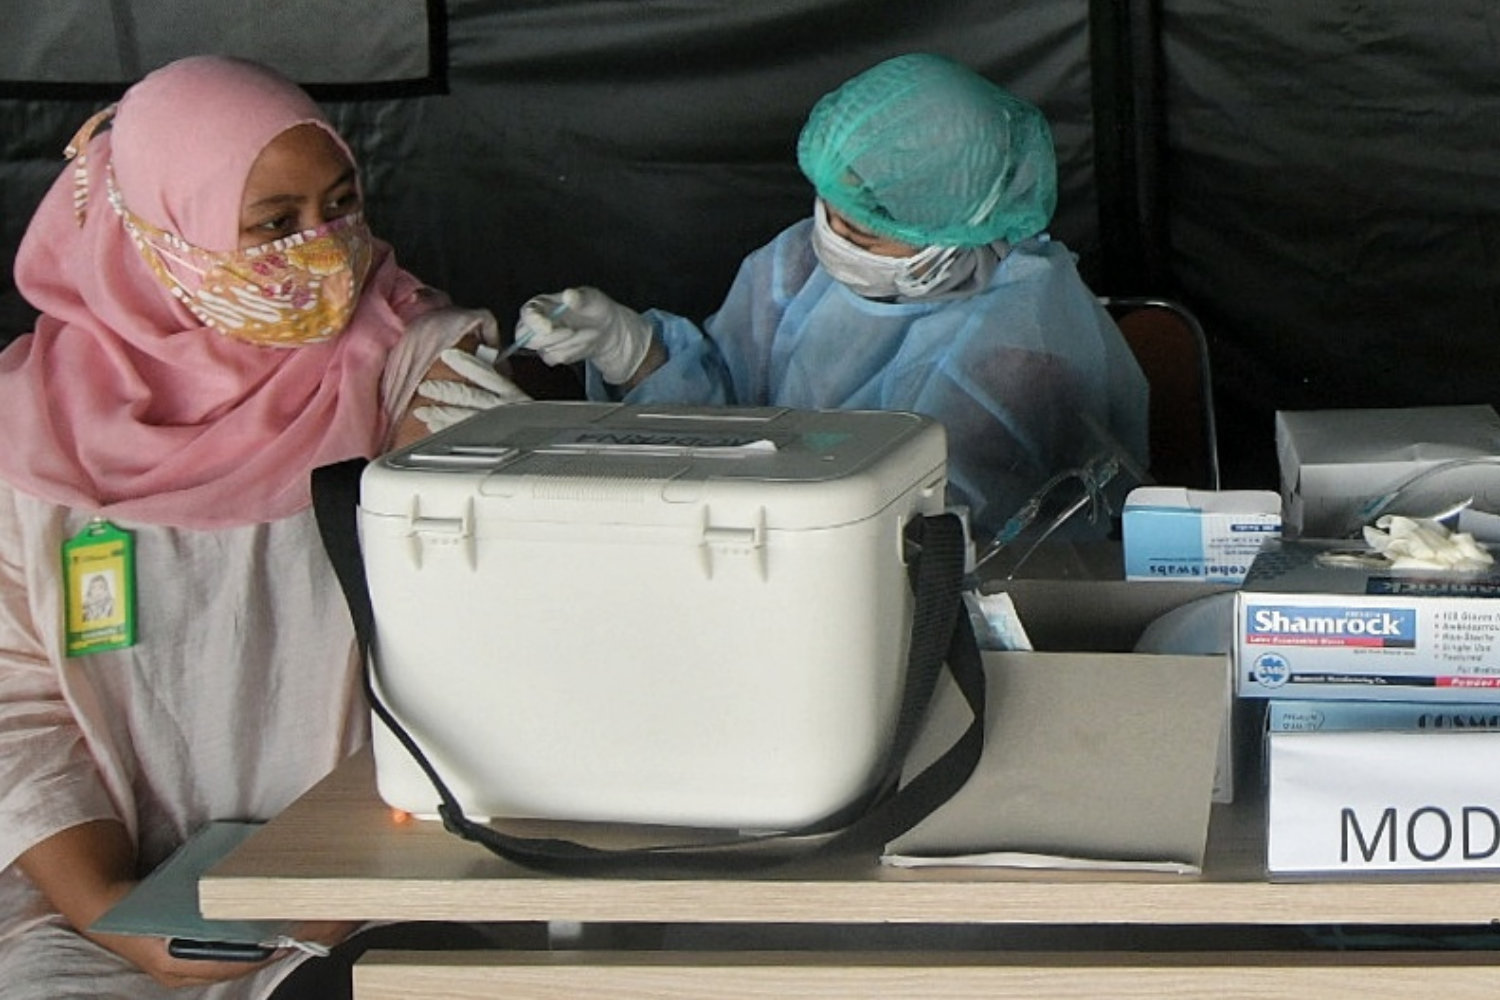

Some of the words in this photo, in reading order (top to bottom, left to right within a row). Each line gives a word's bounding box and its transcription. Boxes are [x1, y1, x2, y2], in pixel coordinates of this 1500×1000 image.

[1205, 564, 1246, 576] cohol
[1254, 610, 1401, 636] Shamrock
[1451, 678, 1492, 687] Powder
